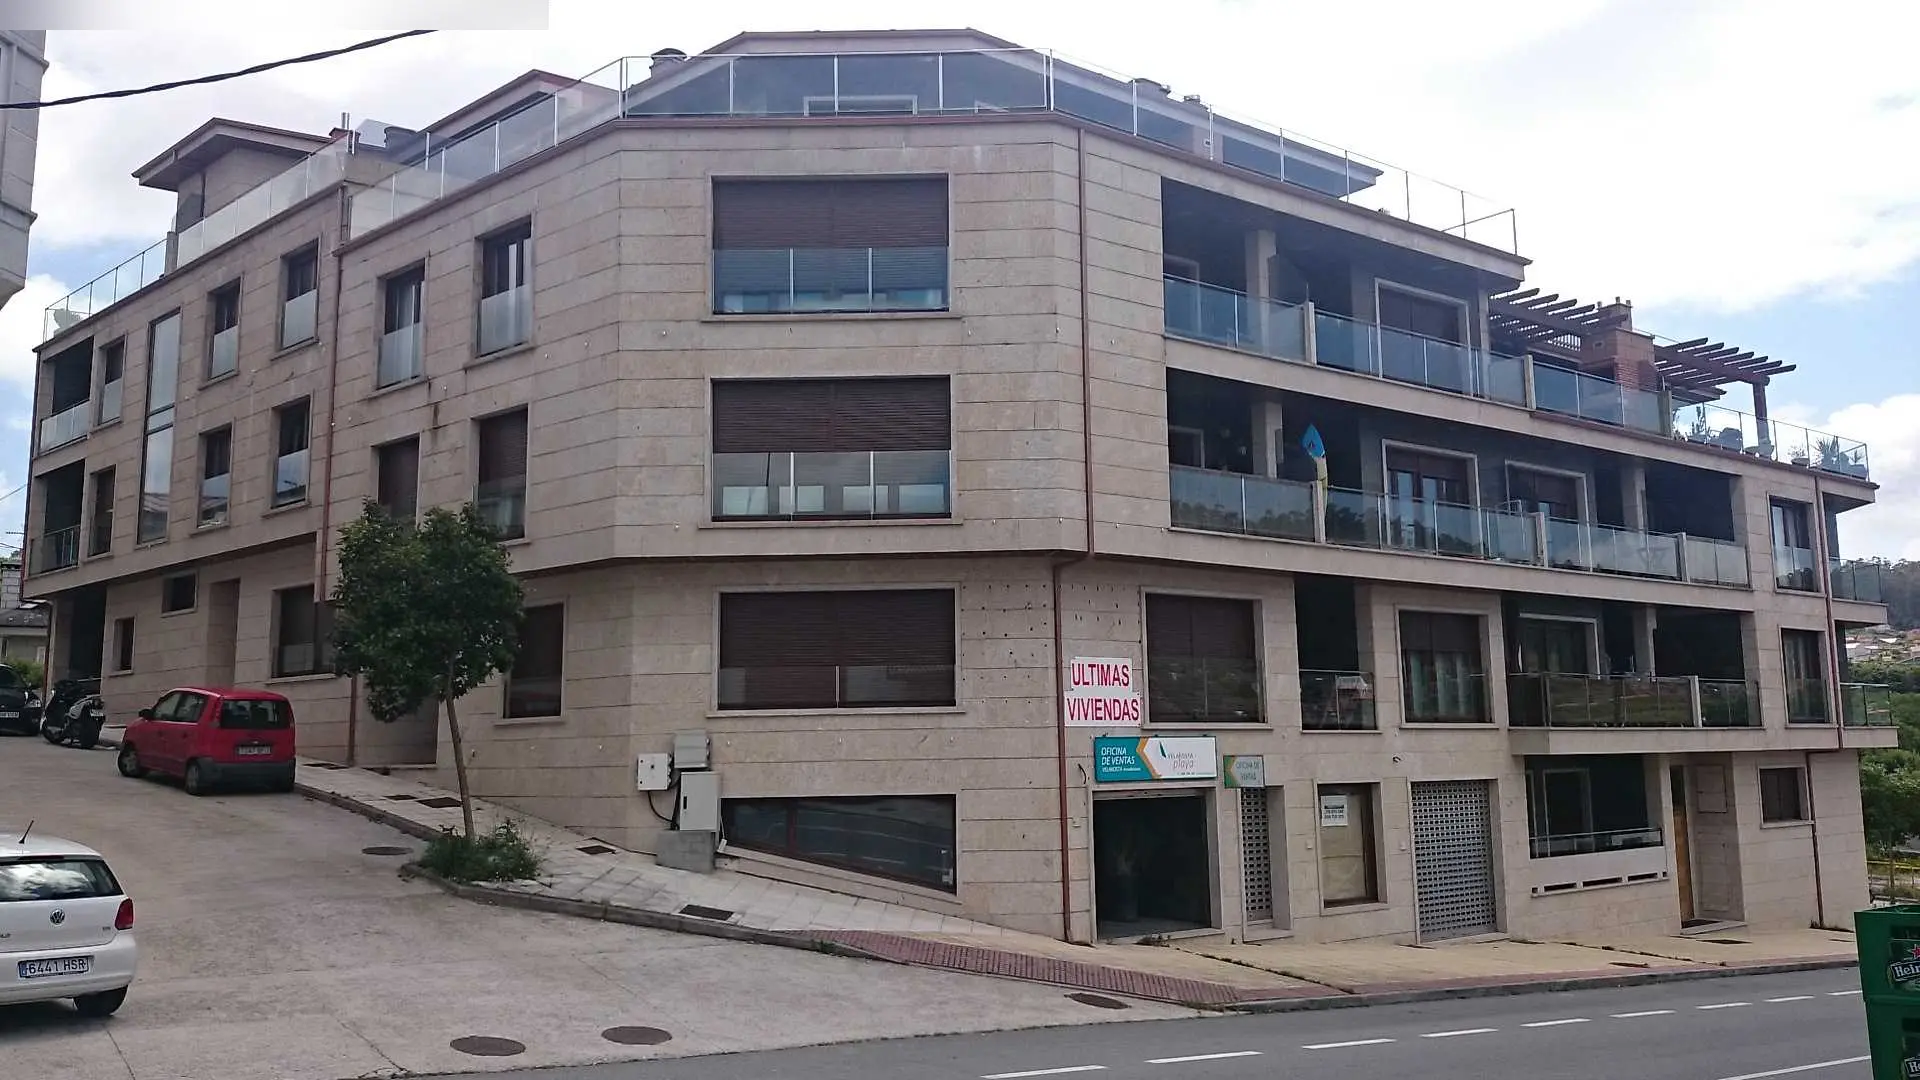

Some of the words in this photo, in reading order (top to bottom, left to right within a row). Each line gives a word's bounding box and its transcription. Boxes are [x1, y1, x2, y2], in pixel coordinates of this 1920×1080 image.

[1071, 663, 1129, 687] ULTIMAS
[1066, 698, 1139, 721] VIVIENDAS
[1101, 747, 1127, 756] OFICINA
[1101, 757, 1111, 766] DE
[1112, 756, 1135, 765] VENTAS
[29, 961, 59, 974] 6441
[63, 959, 86, 971] HSR
